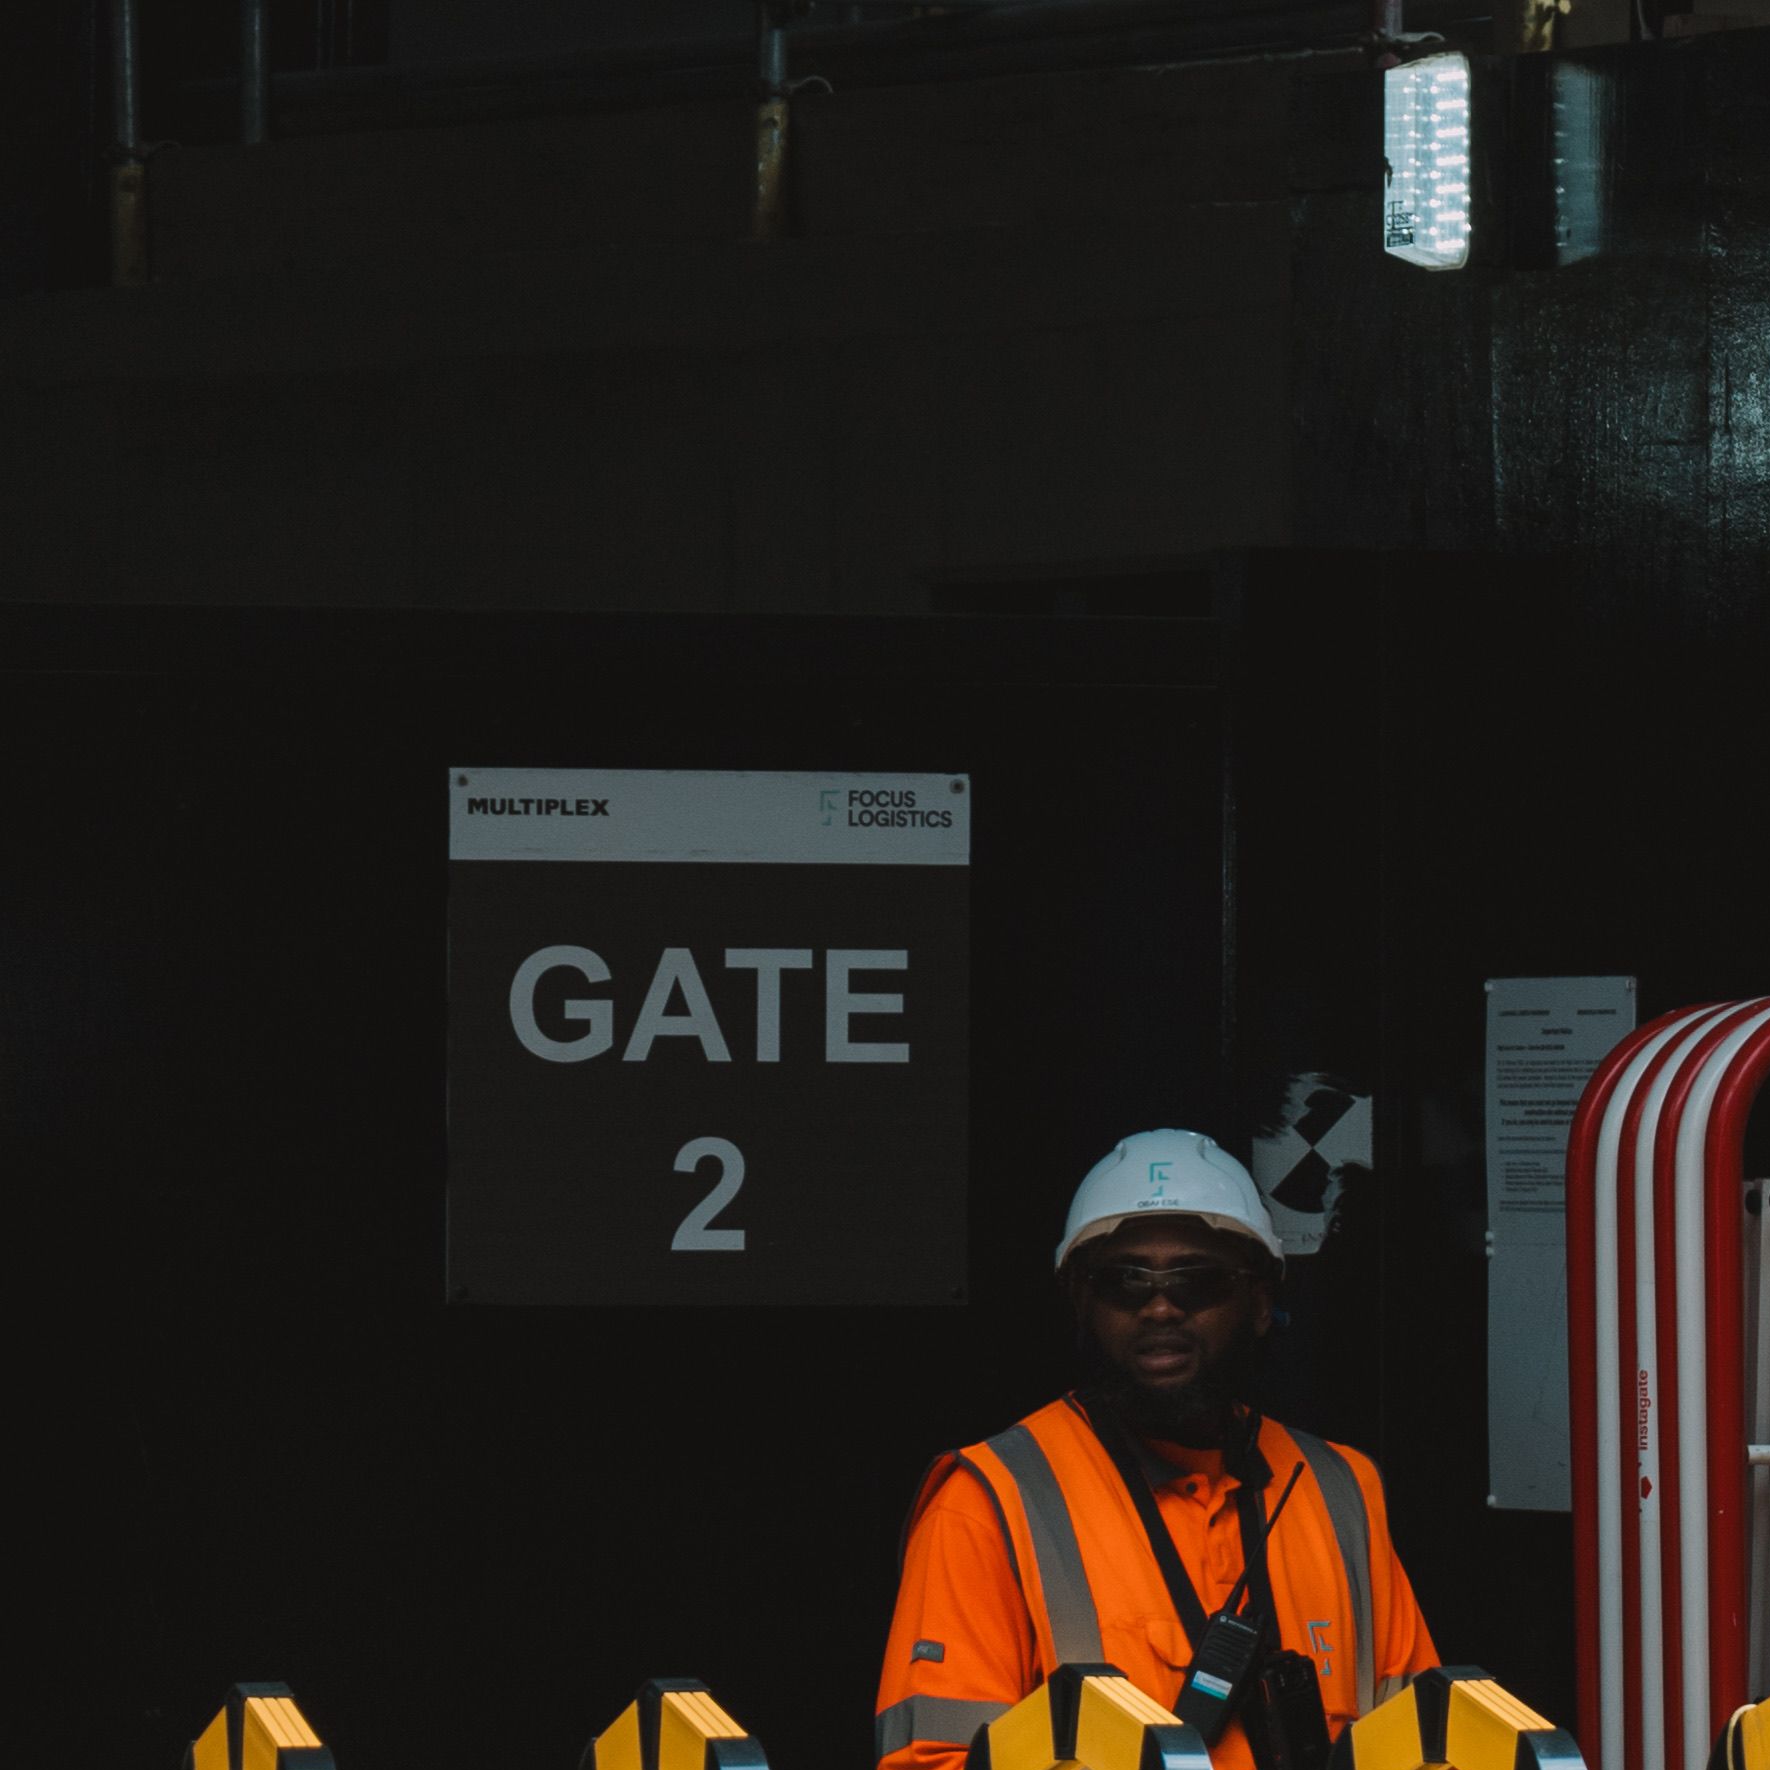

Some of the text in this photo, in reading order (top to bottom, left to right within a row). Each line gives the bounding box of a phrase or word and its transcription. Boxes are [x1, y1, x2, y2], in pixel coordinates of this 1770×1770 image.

[467, 797, 609, 817] MULTIPLEX
[848, 790, 916, 808] FOCUS
[847, 809, 953, 828] LOGISTICS
[509, 945, 910, 1062] GATE
[671, 1136, 746, 1251] 2
